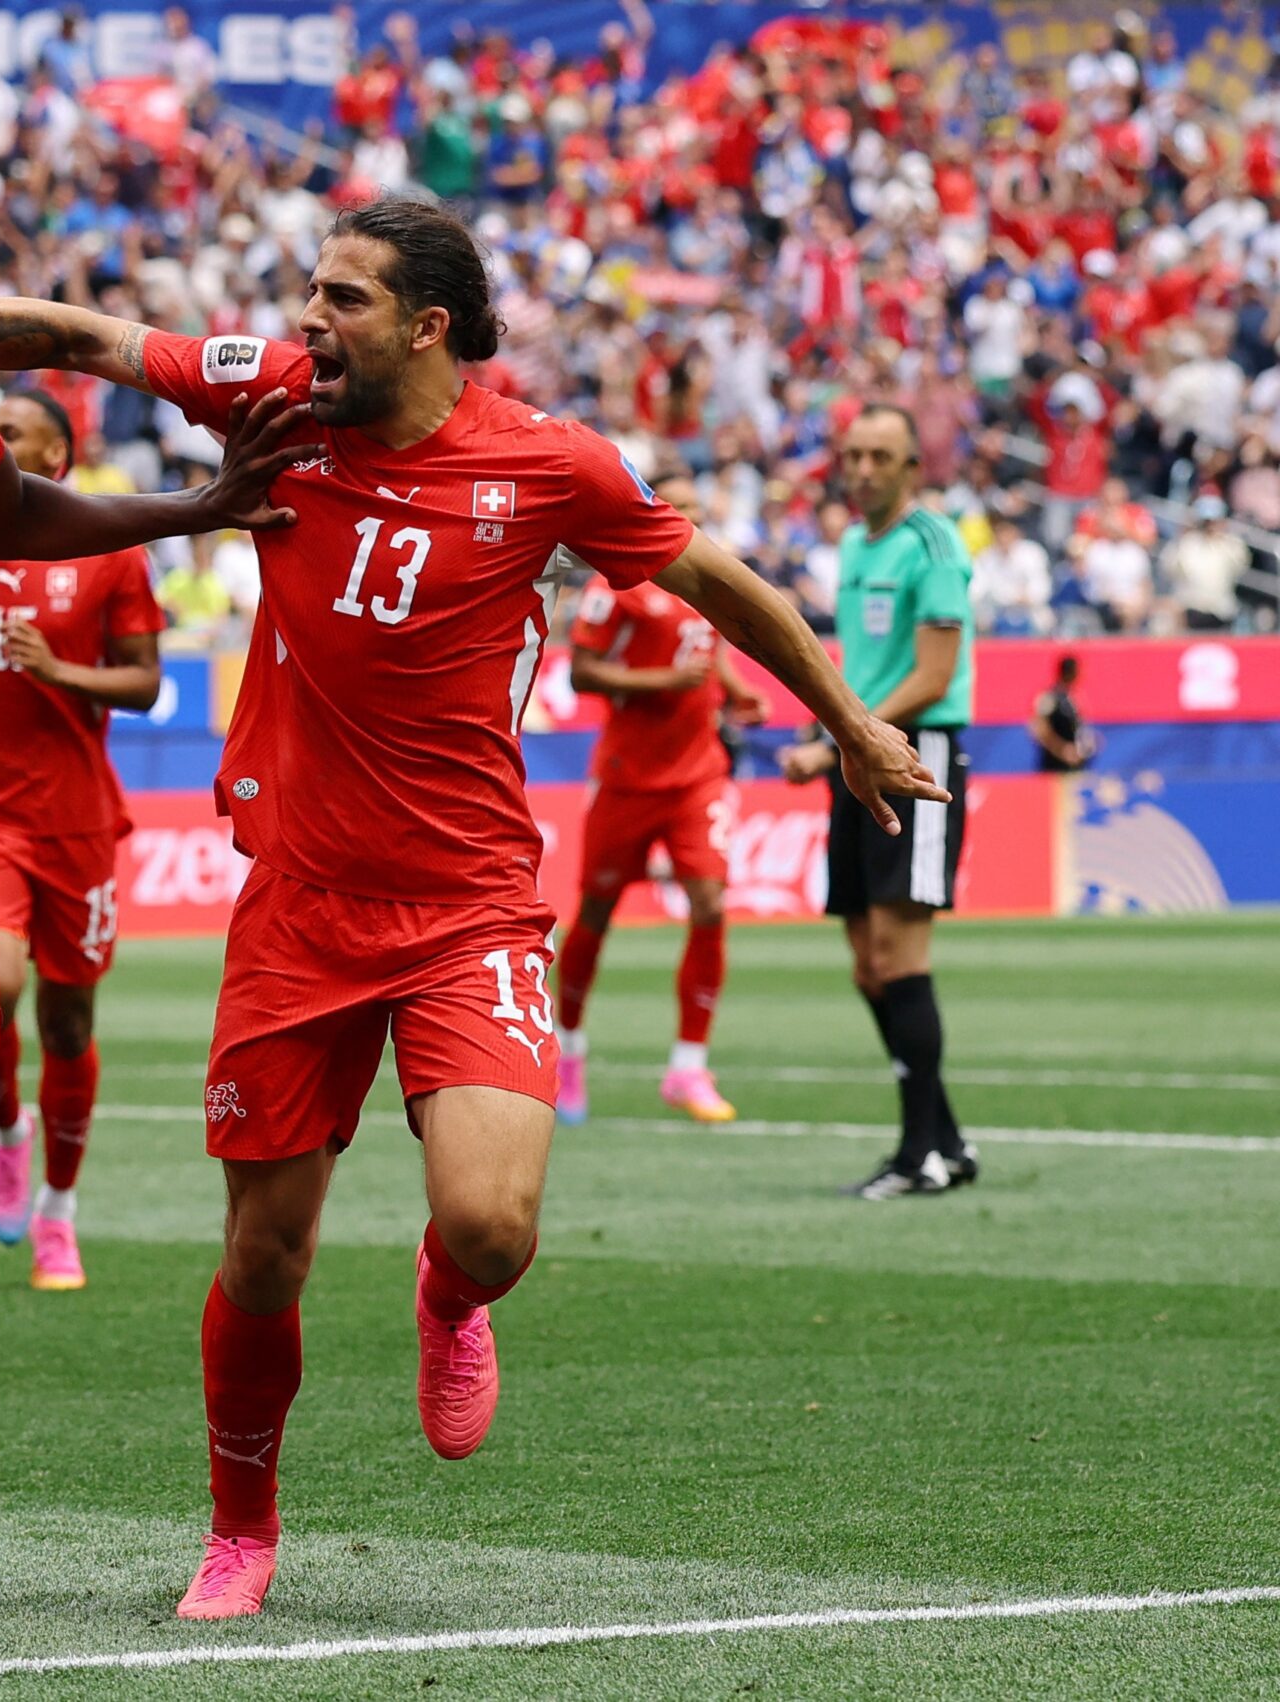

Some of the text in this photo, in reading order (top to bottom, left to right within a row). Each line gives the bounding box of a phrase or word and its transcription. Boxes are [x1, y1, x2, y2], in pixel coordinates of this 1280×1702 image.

[332, 516, 432, 625] 13
[81, 878, 119, 948] 15
[481, 948, 553, 1036] 13
